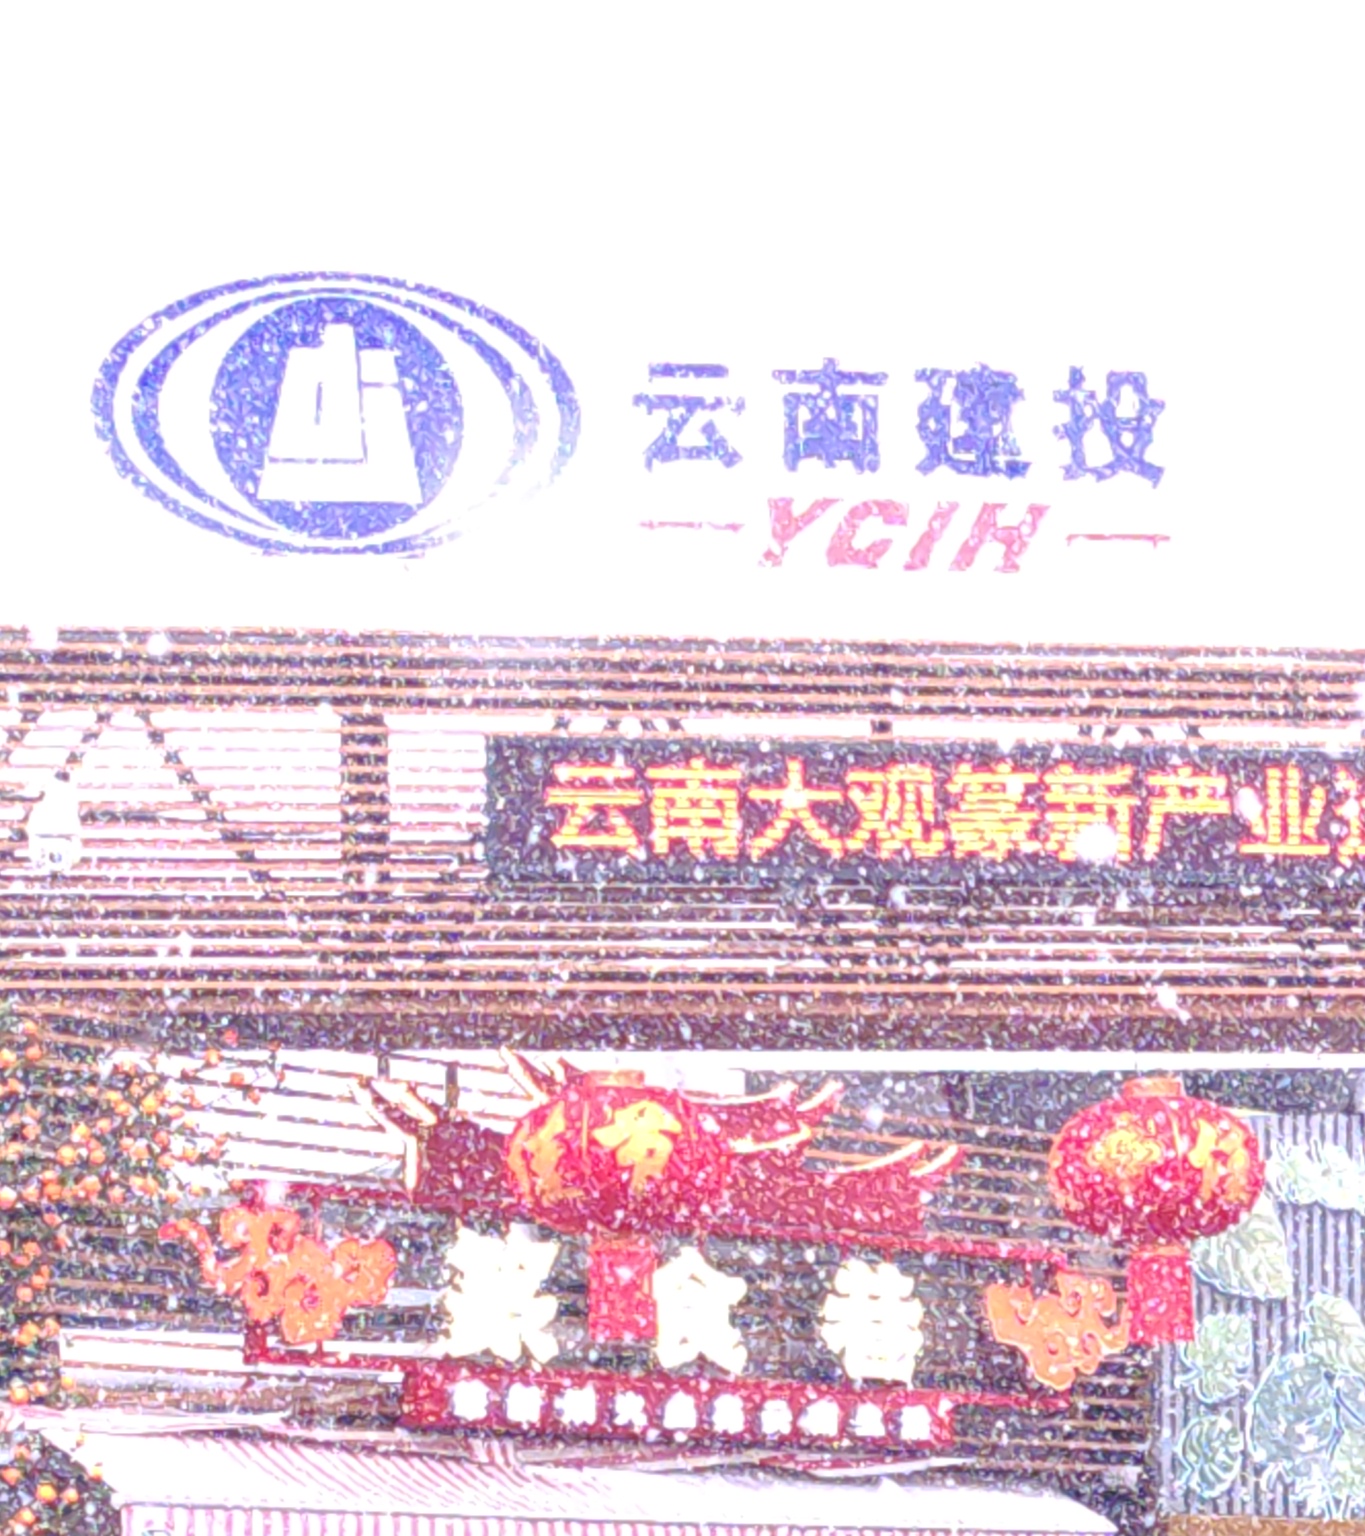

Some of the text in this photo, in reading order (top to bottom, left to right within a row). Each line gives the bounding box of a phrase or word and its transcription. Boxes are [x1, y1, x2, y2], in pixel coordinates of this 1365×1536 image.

[631, 356, 1167, 489] 云南建投
[758, 496, 1051, 573] YCIH
